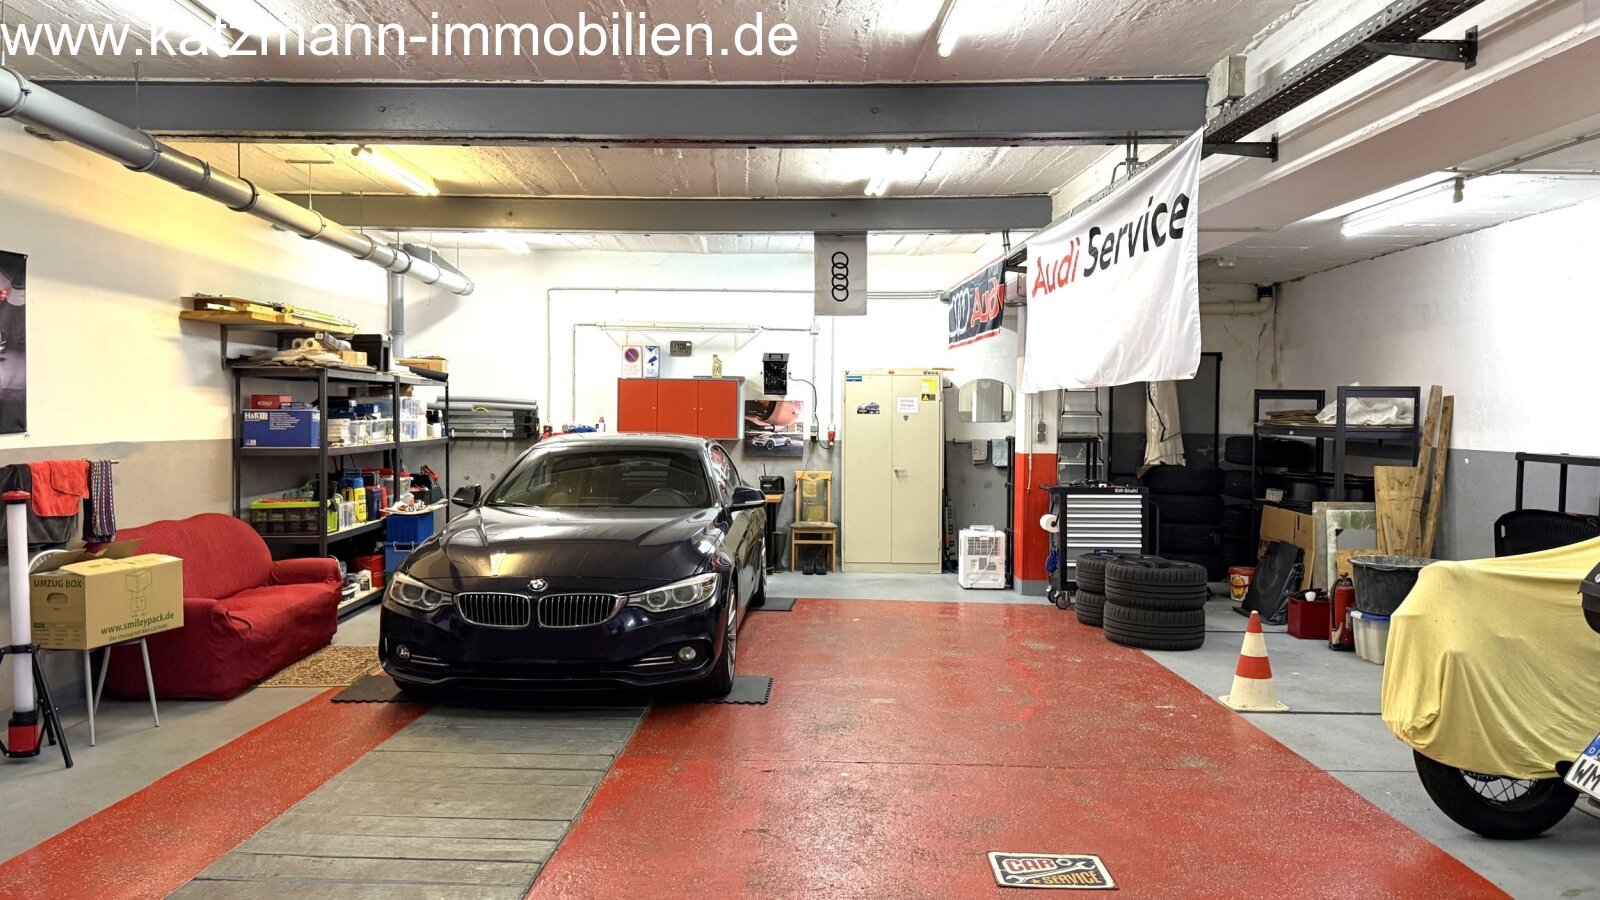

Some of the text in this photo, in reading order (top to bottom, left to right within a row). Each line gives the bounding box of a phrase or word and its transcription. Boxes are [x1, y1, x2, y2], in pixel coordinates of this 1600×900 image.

[1032, 193, 1190, 298] Audi Service
[33, 579, 82, 588] UMZUG BOX
[100, 611, 175, 635] www.smileypack.de
[1588, 746, 1596, 754] D
[1002, 859, 1056, 873] CAR
[1043, 871, 1101, 884] SERVICE
